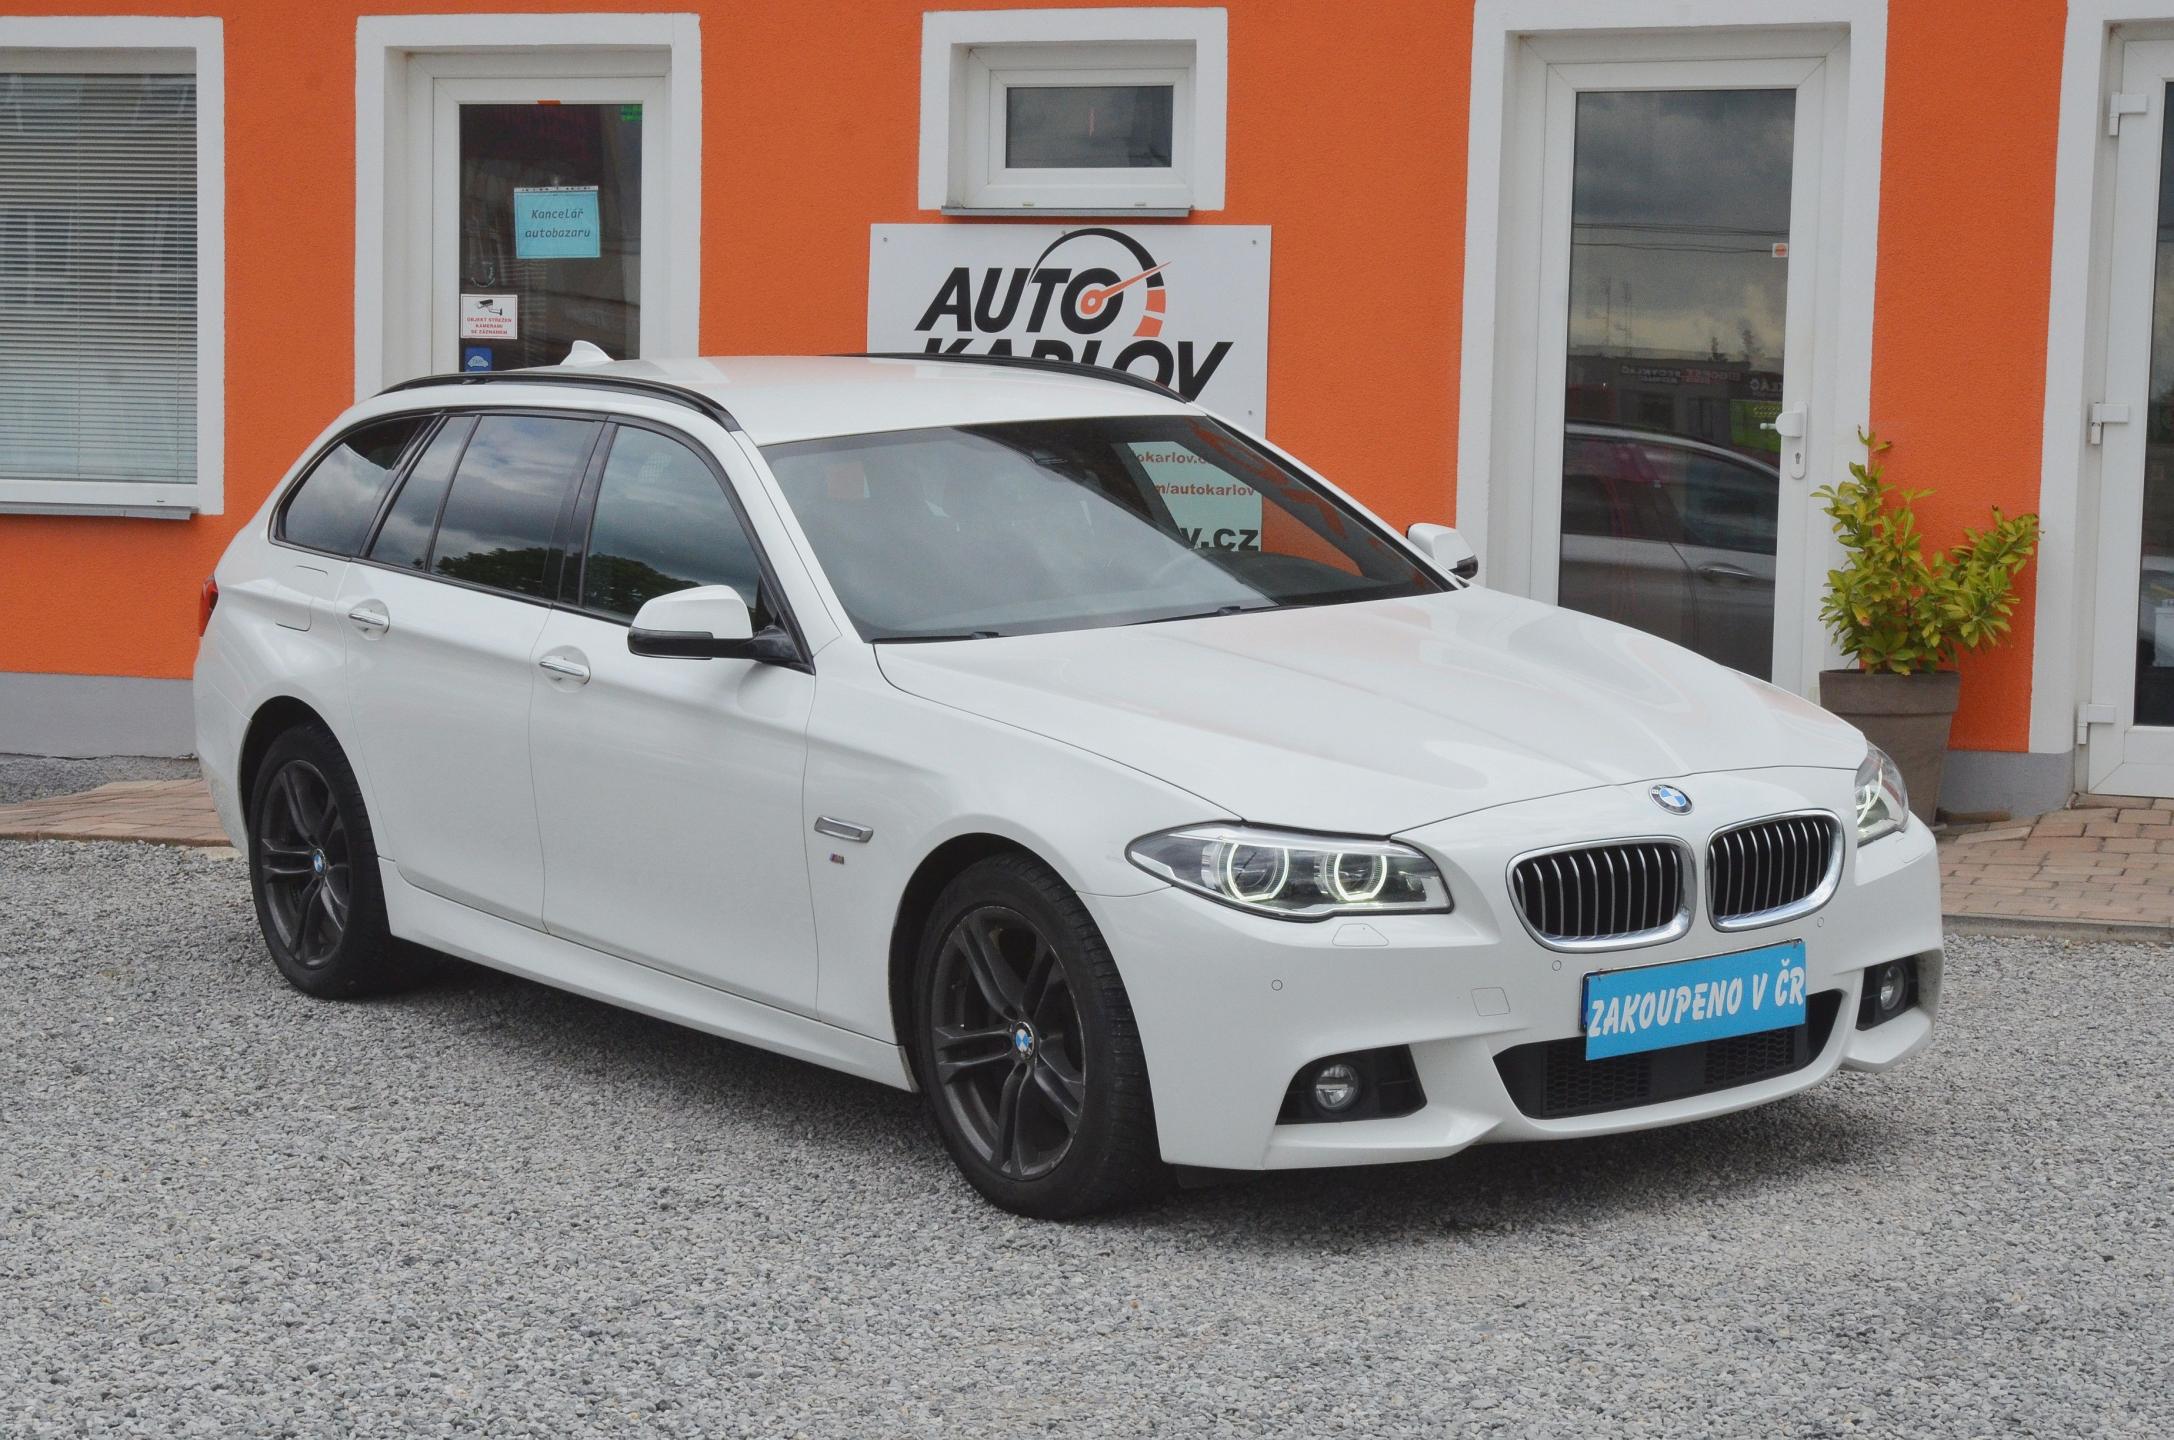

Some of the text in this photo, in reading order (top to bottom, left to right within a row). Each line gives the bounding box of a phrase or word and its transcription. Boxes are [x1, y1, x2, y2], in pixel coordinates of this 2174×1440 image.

[531, 207, 584, 219] Kancelář
[525, 228, 591, 239] autobazaru
[914, 267, 1124, 335] AUTO
[1588, 958, 1805, 1037] ZAKOUPENO V ČR
